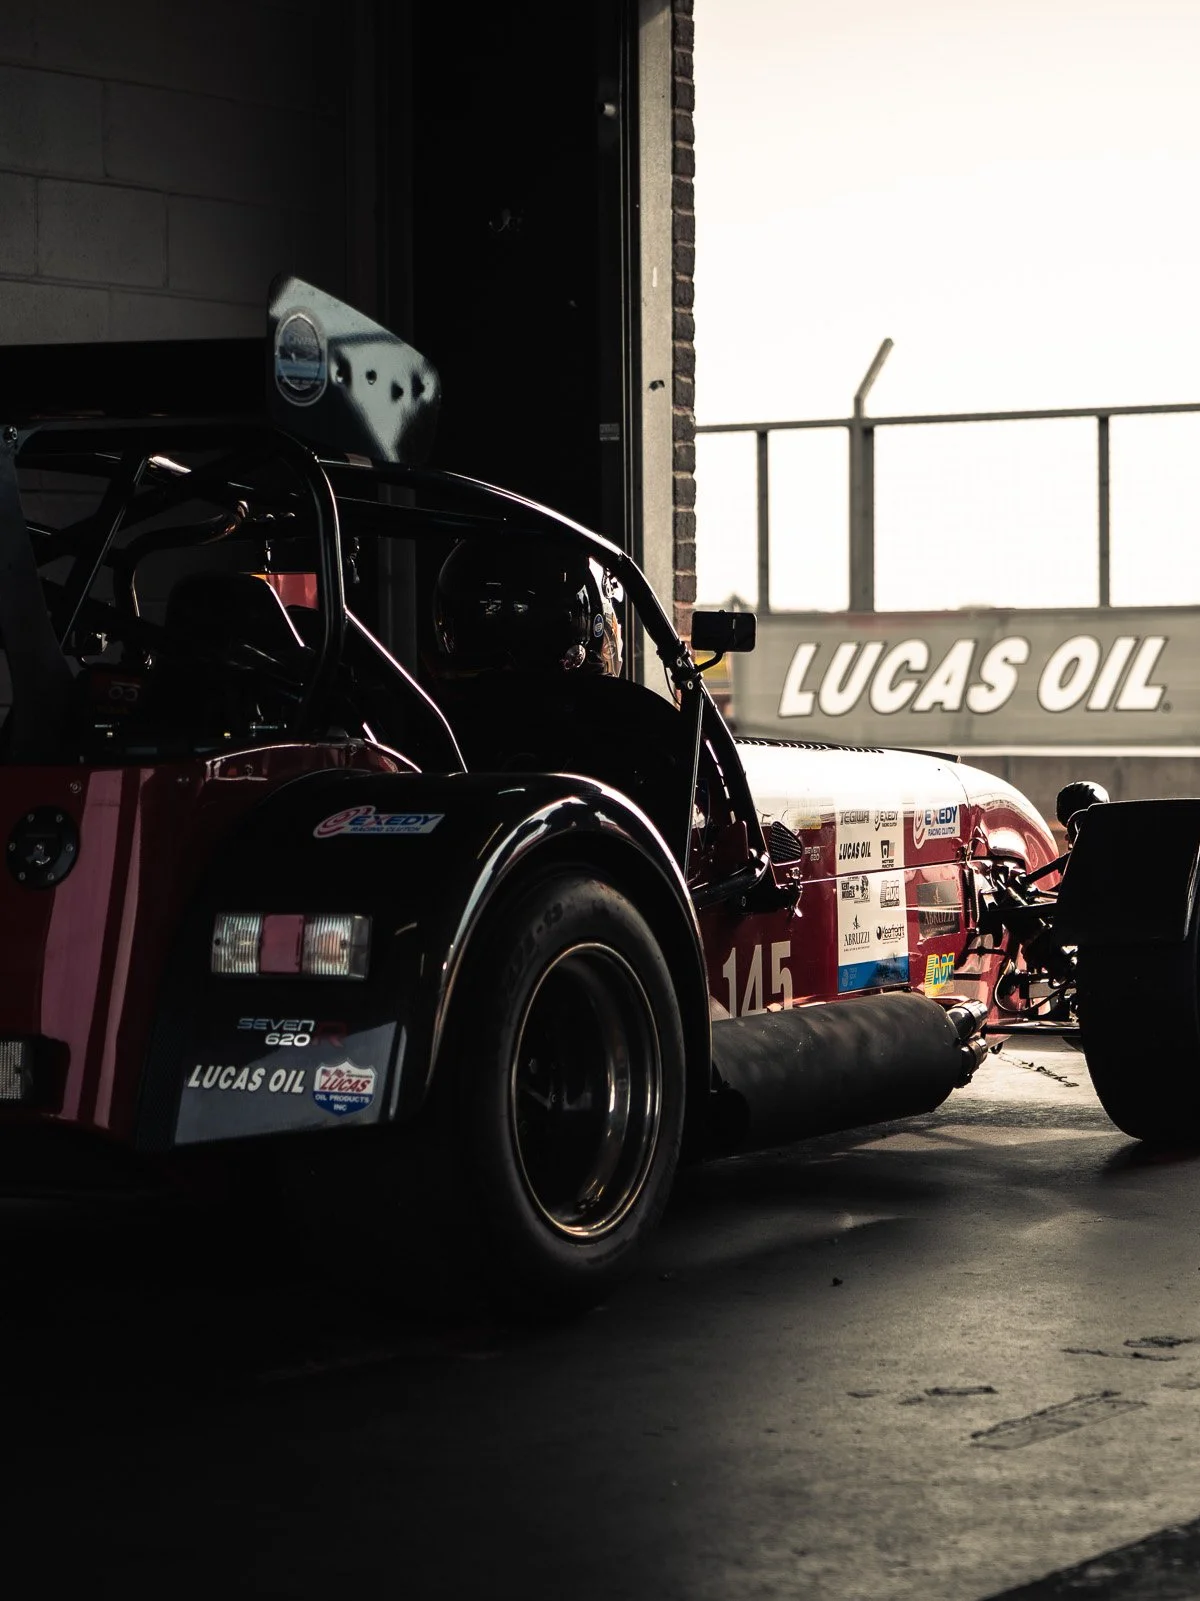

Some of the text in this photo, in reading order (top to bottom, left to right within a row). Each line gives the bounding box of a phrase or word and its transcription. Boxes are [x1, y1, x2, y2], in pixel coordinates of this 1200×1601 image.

[778, 634, 1168, 717] LUCAS OIL
[348, 815, 440, 827] EXEDY
[925, 805, 957, 827] EXEDY
[839, 840, 871, 860] LUCAS OIL
[844, 931, 870, 946] ABRUZZI
[723, 941, 793, 1018] 145
[237, 1018, 316, 1032] SEVEN
[265, 1033, 311, 1047] 620
[187, 1065, 306, 1094] LUCAS OIL
[320, 1078, 371, 1092] LUCAS
[329, 1094, 369, 1104] PRODUCTS
